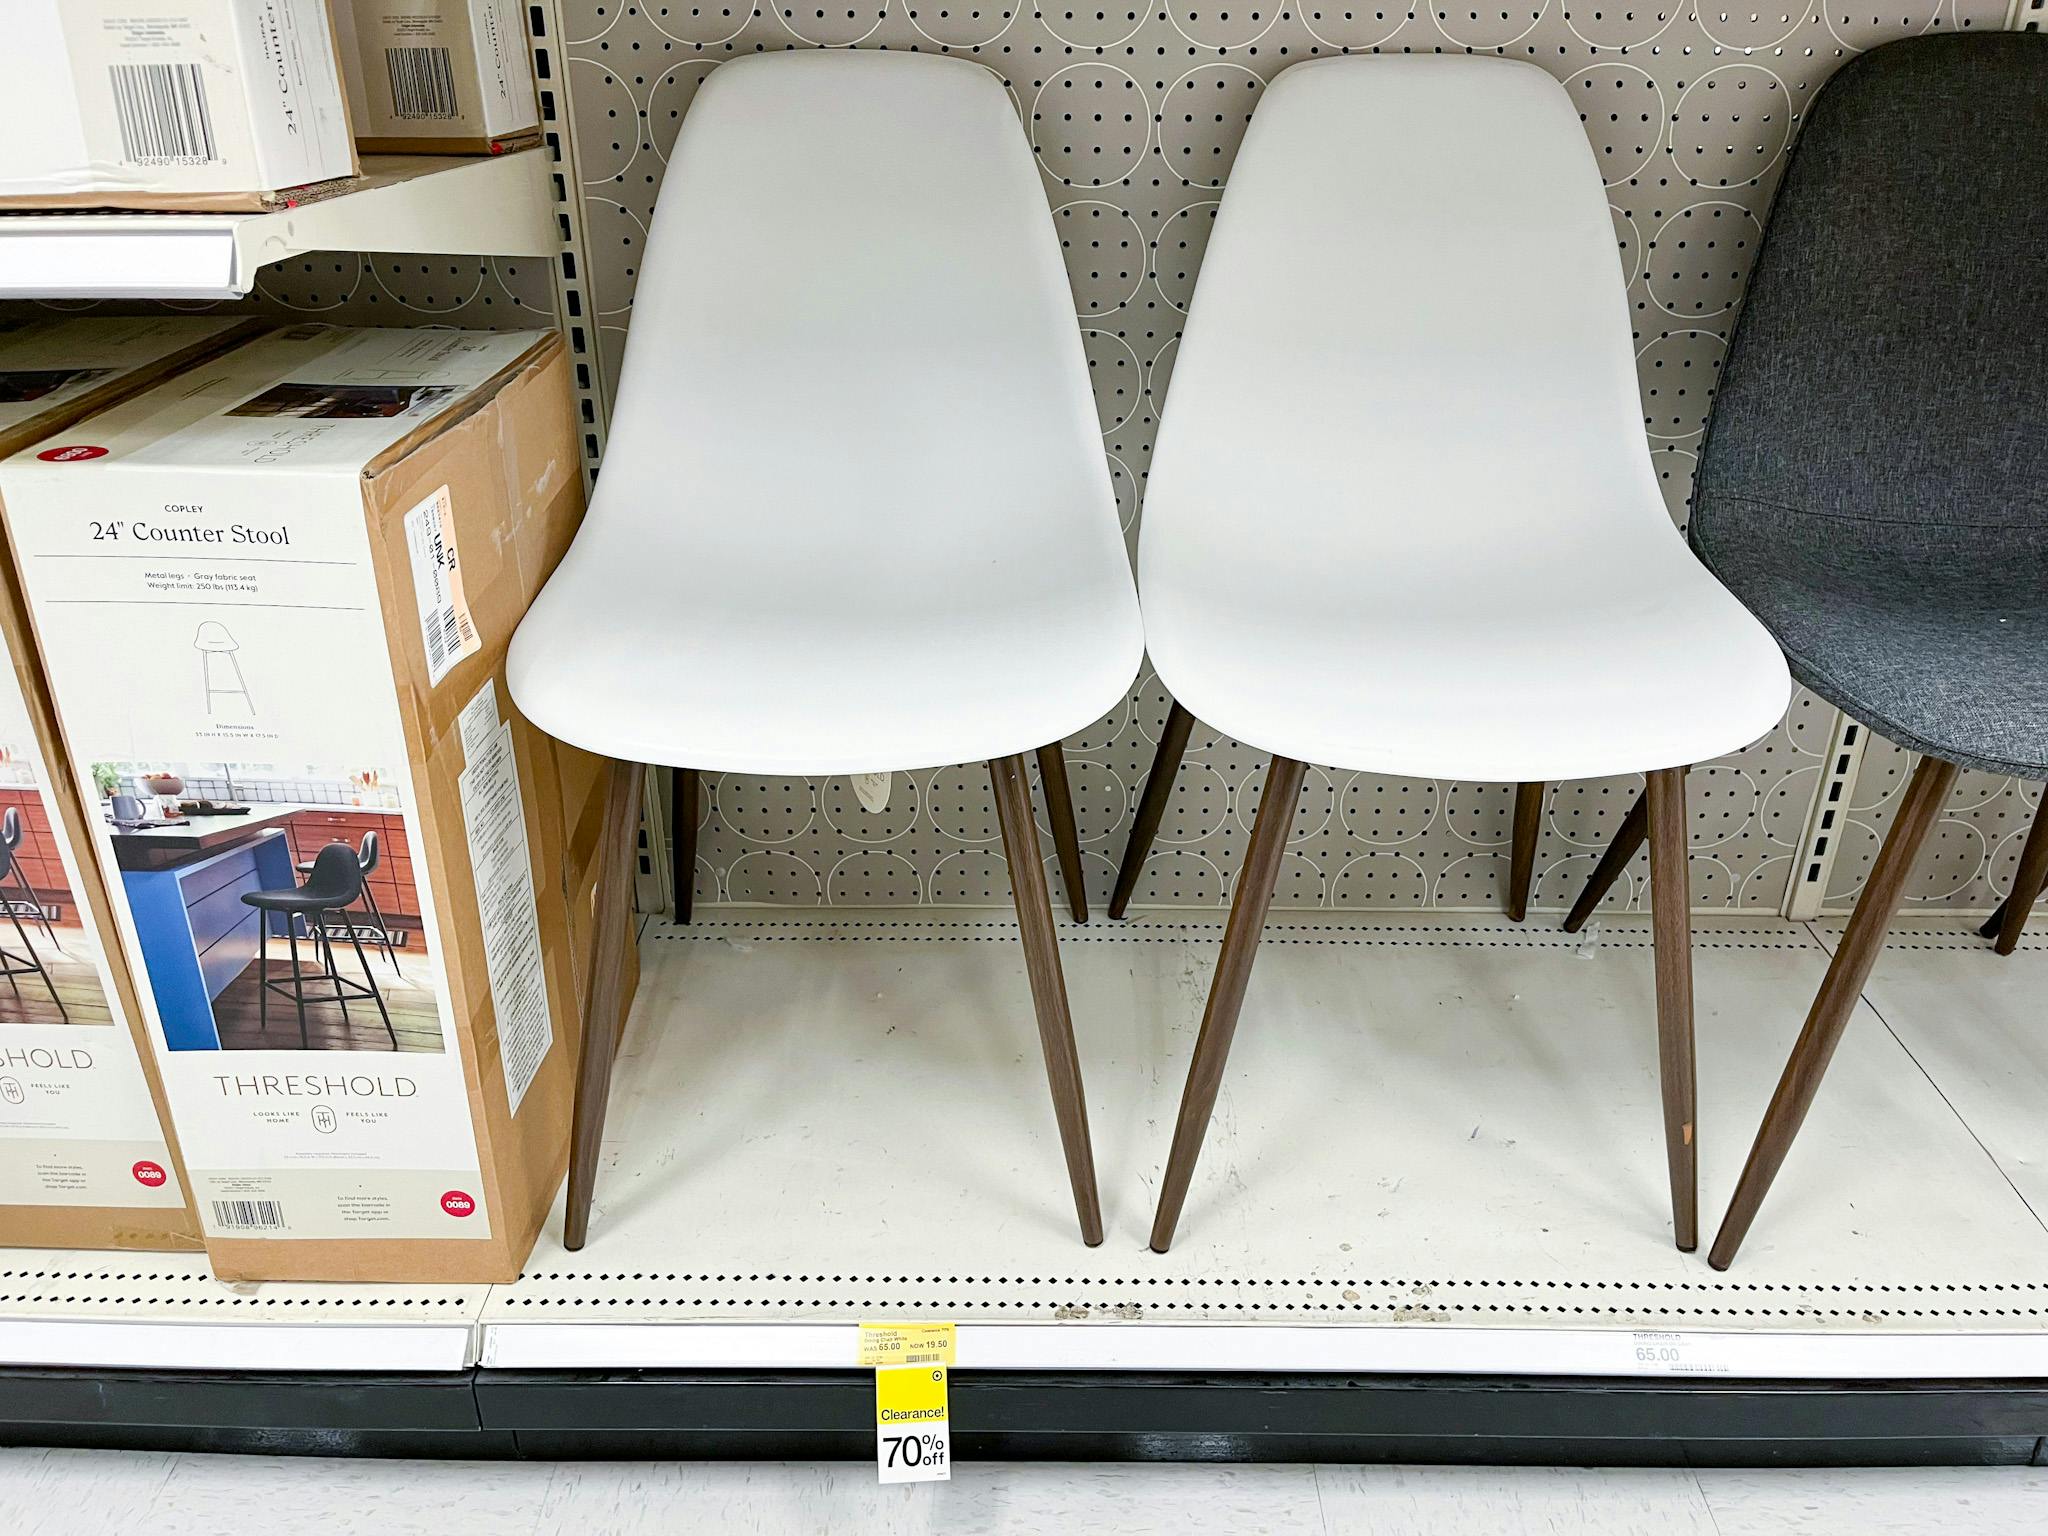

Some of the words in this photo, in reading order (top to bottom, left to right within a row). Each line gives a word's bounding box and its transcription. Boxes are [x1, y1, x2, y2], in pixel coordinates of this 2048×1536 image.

[136, 156, 171, 167] 92490
[175, 156, 208, 166] 15328
[164, 504, 204, 513] COPLEY
[89, 521, 124, 541] 24"
[132, 522, 225, 543] Counter
[231, 525, 290, 545] Stool
[433, 532, 445, 569] UNK
[447, 547, 457, 572] CR
[144, 572, 167, 580] Metal
[168, 572, 185, 581] legs
[194, 573, 213, 582] Gray
[215, 573, 238, 581] fabric
[147, 582, 176, 591] Weight
[212, 583, 224, 591] lbs
[246, 584, 259, 593] kg)
[213, 1075, 417, 1097] THRESHOLD
[137, 1170, 162, 1179] 0089
[446, 1200, 470, 1209] 0089
[1633, 1333, 1681, 1341] THRESHOLD
[878, 1343, 901, 1351] 65.00
[926, 1340, 948, 1349] 19.50
[1636, 1347, 1680, 1362] 65.00
[881, 1406, 944, 1421] Clearance!
[923, 1452, 944, 1466] off
